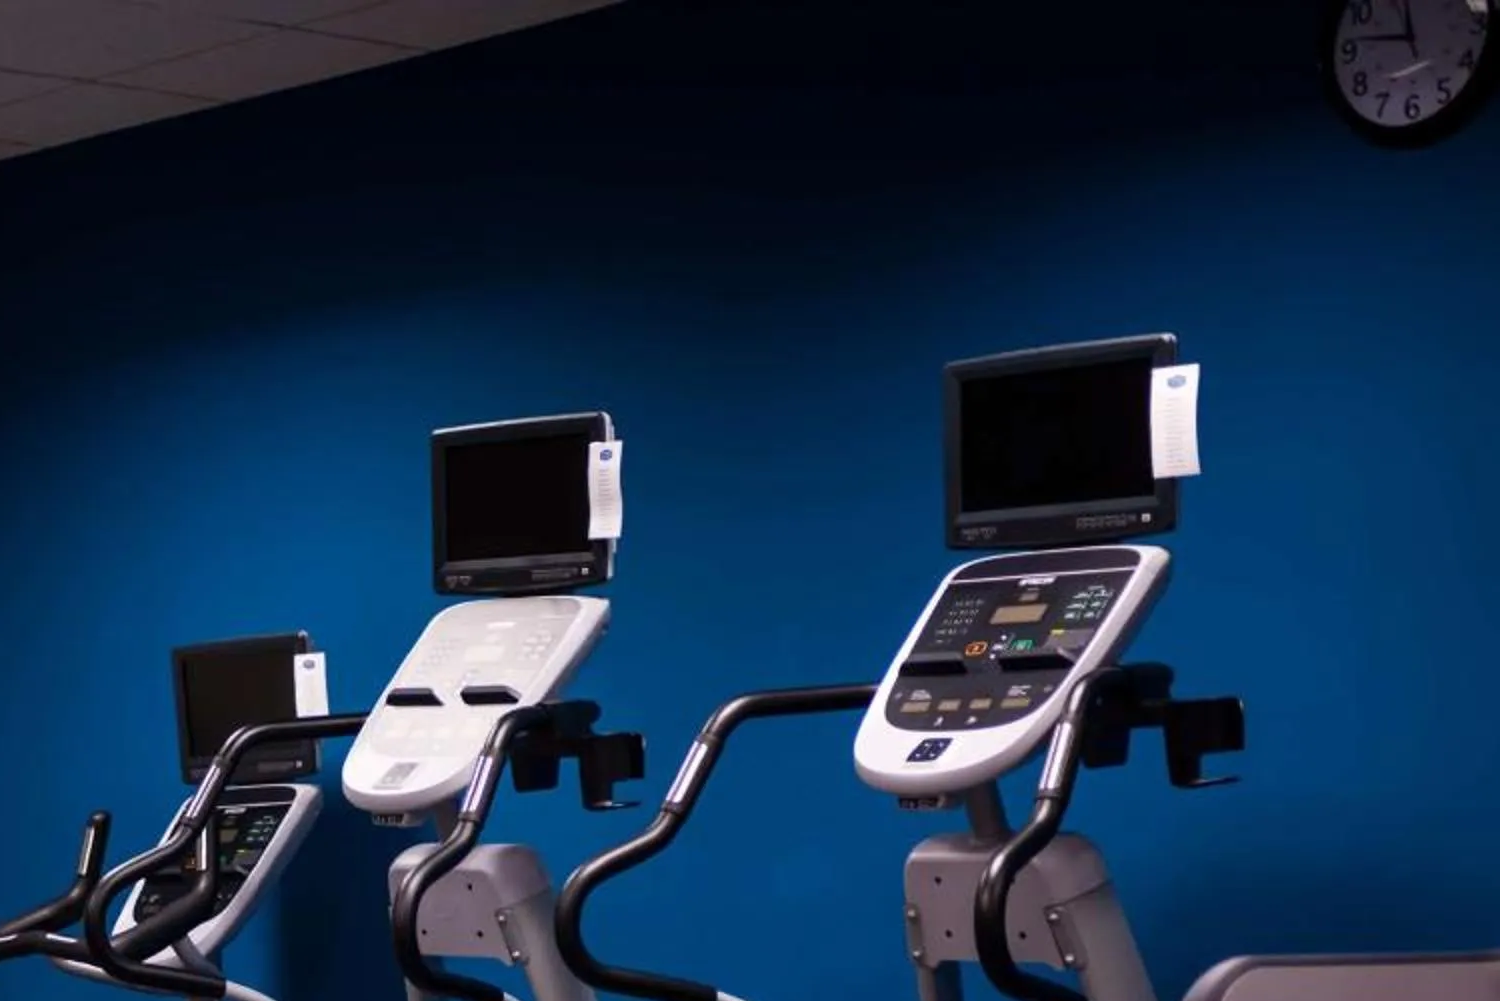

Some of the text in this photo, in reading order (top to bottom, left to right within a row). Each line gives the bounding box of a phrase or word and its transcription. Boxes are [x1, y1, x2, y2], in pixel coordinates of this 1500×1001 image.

[1341, 39, 1357, 64] 9
[1457, 48, 1474, 70] 4
[1352, 71, 1367, 97] 8
[1436, 77, 1452, 104] 5
[1375, 92, 1390, 119] 7
[1404, 94, 1421, 119] 6
